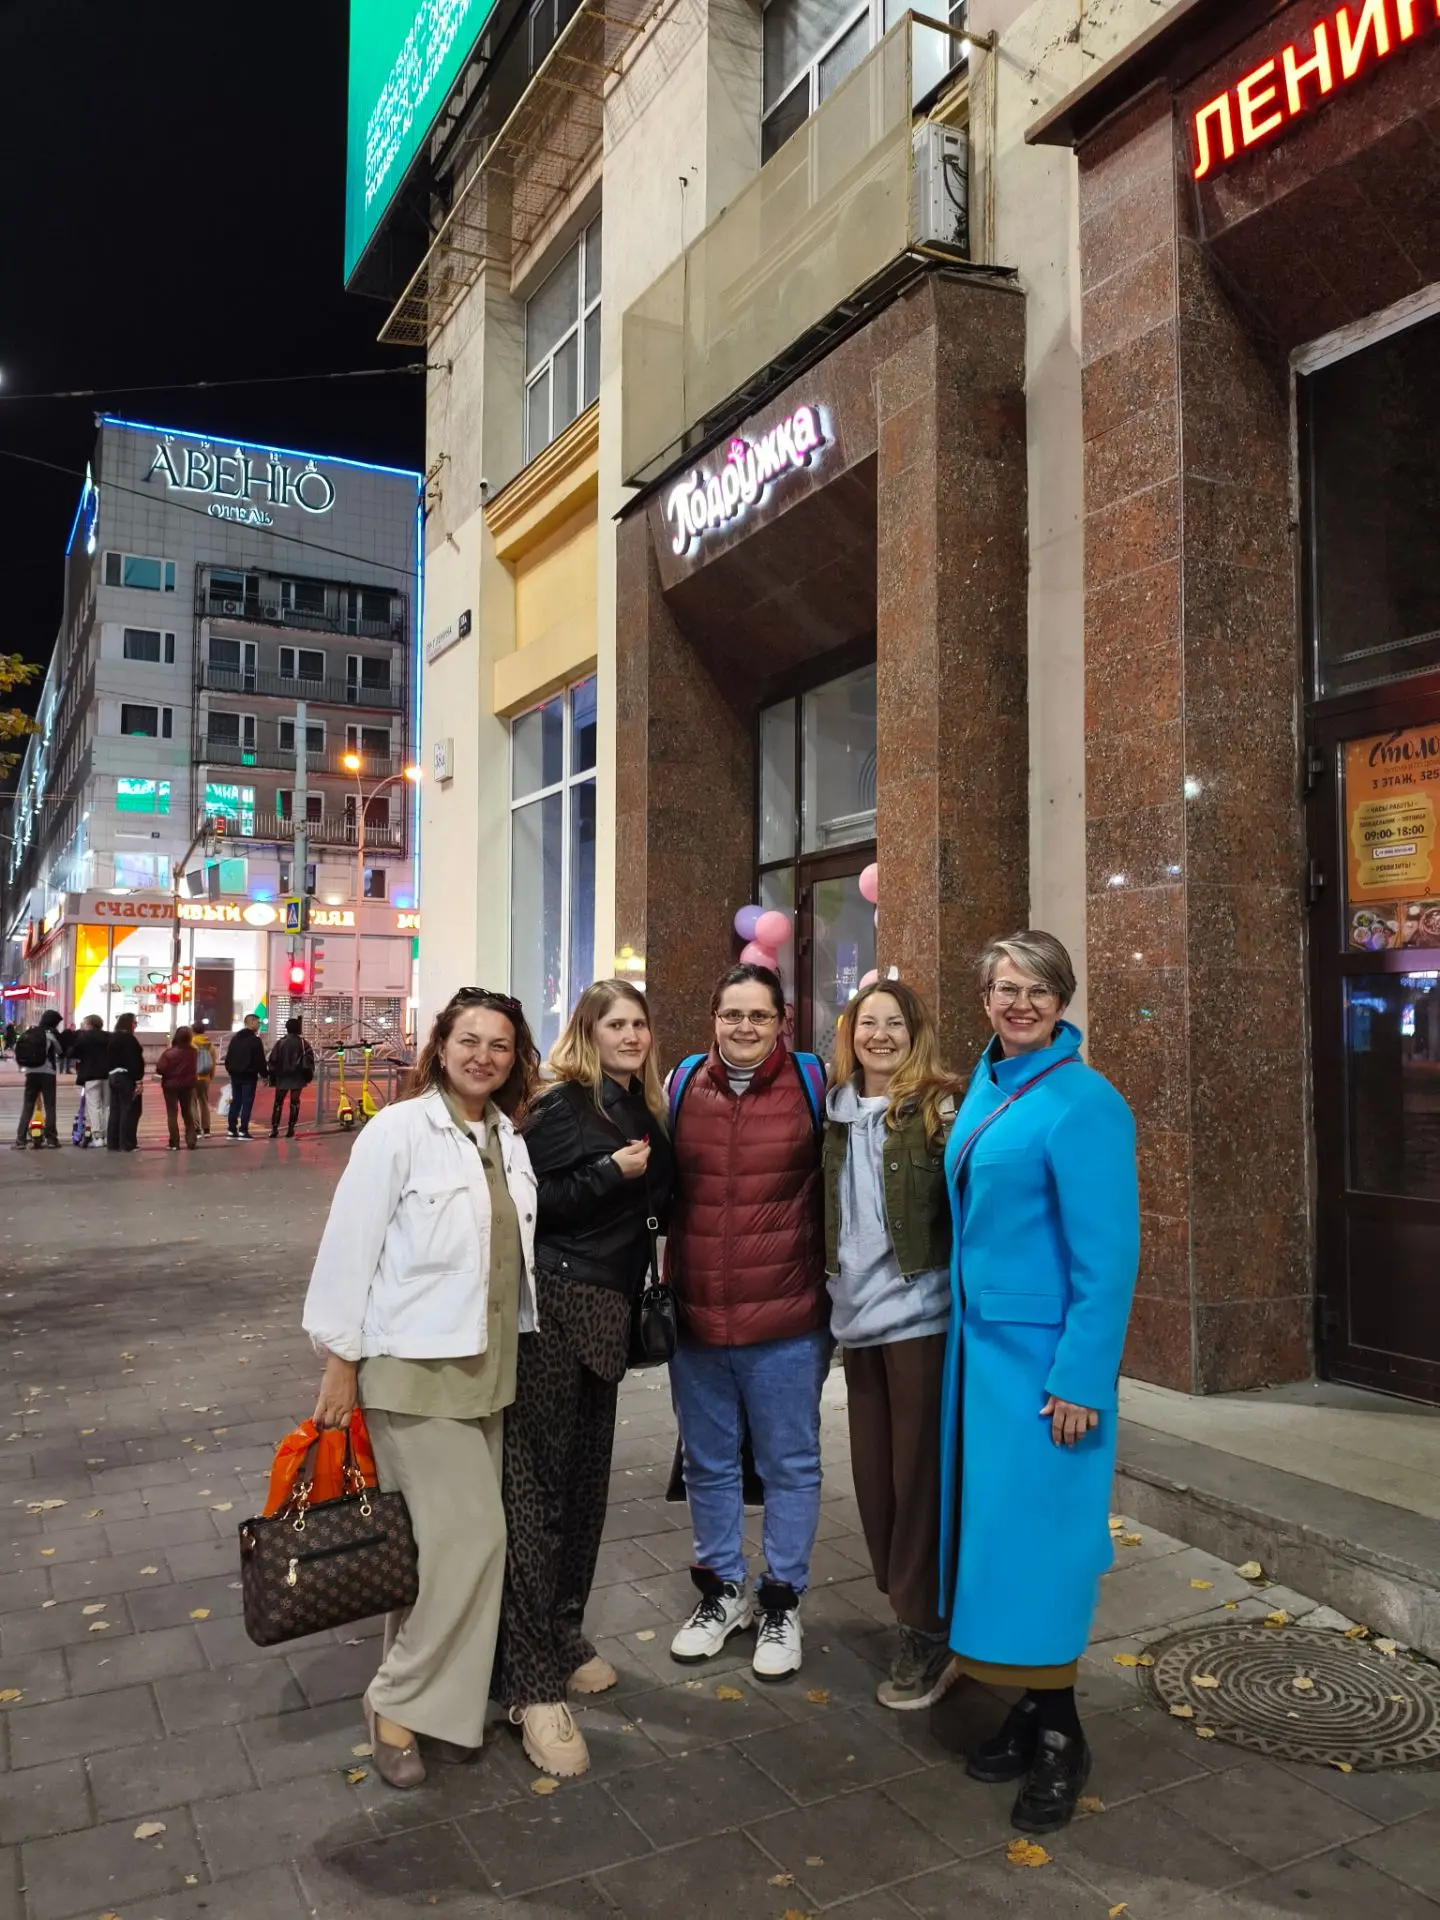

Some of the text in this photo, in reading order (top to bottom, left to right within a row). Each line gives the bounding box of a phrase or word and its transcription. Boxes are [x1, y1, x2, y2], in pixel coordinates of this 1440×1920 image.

[141, 443, 336, 515] АВЕНЮ
[668, 406, 826, 556] Подружка
[207, 503, 274, 526] ОТЕЛЬ
[94, 901, 242, 922] счастливый
